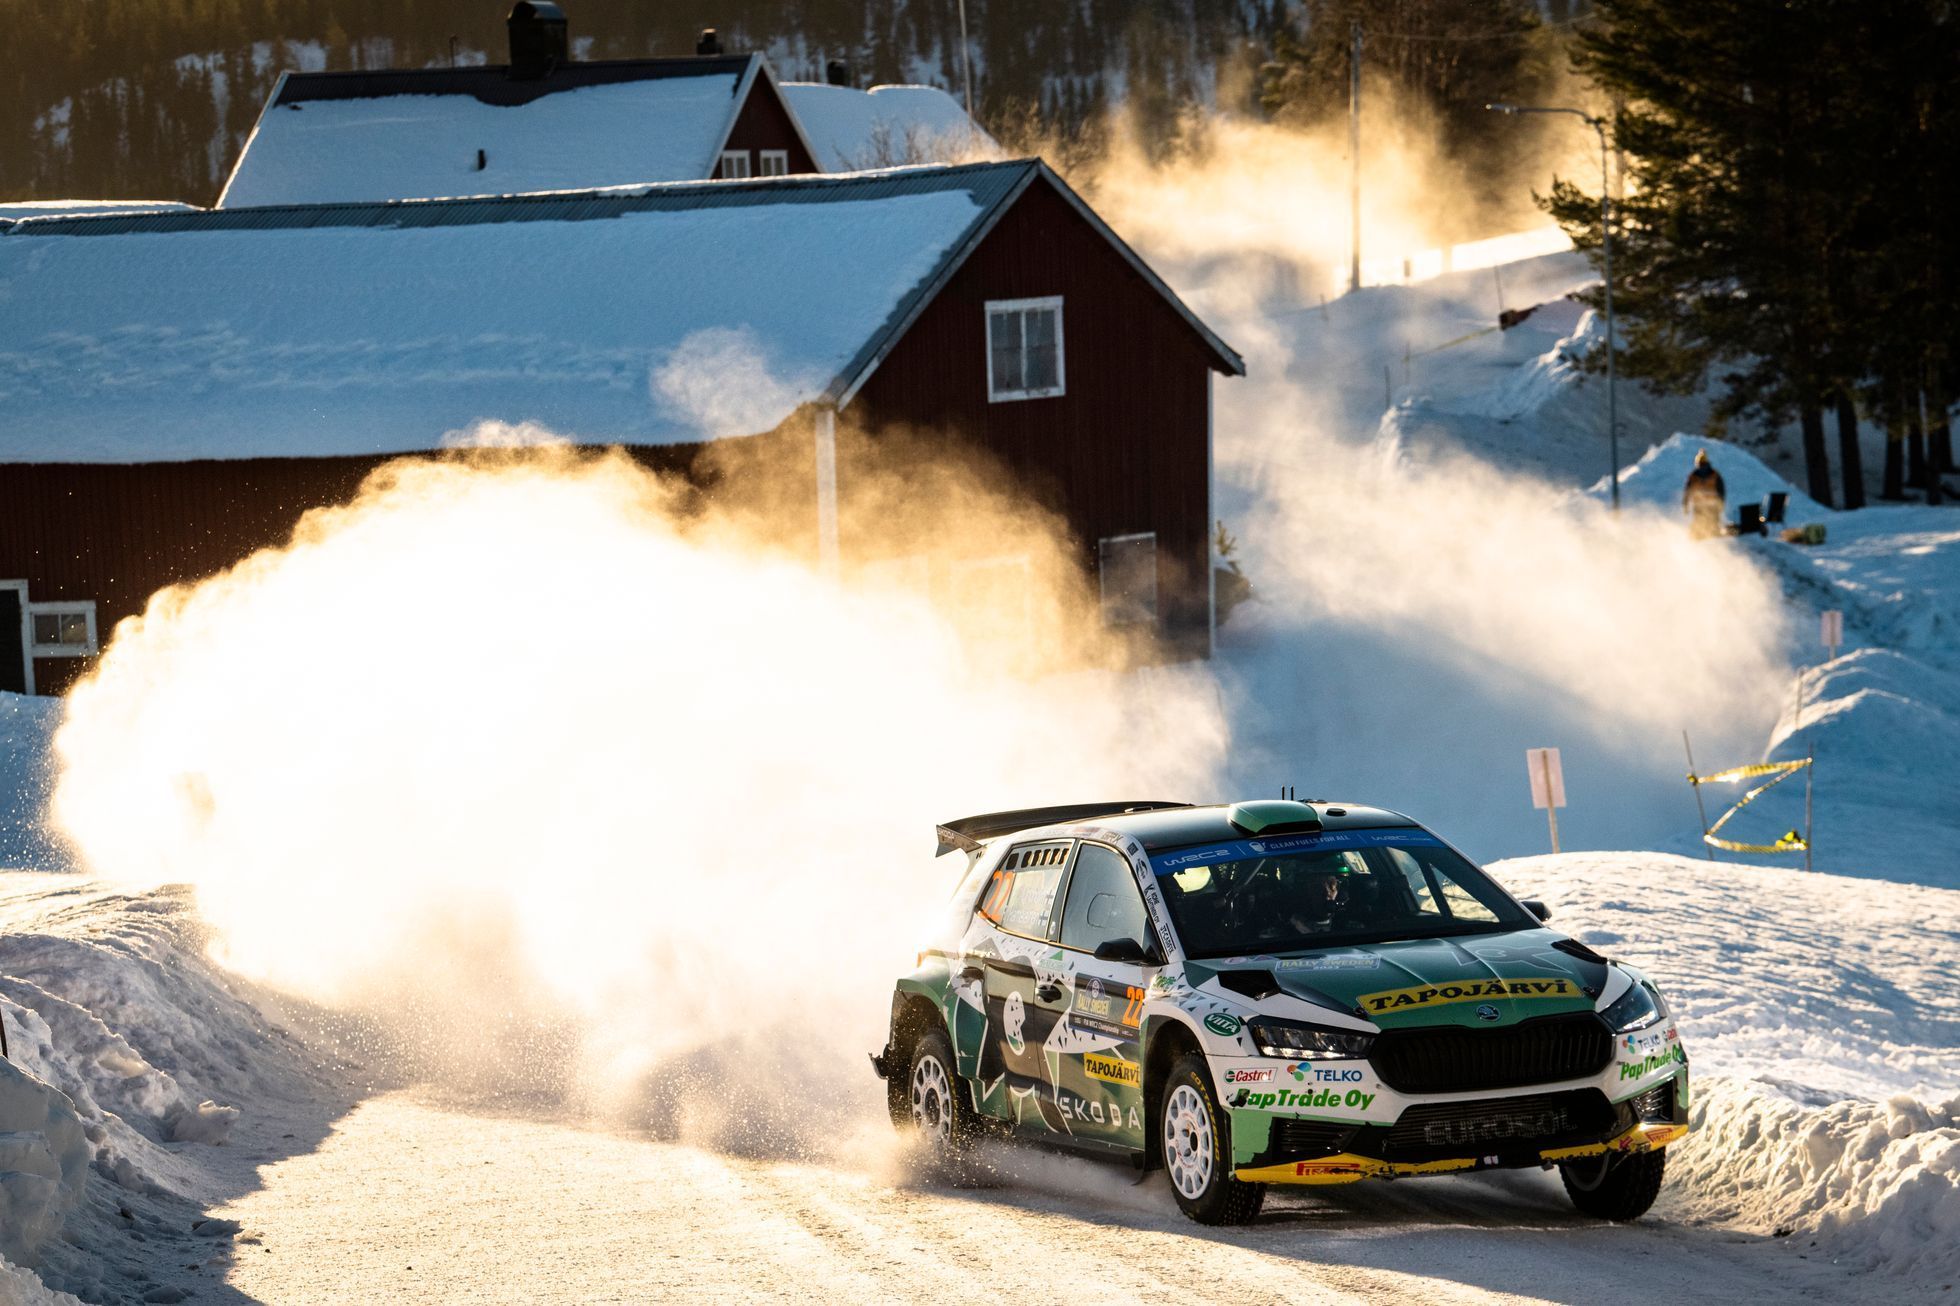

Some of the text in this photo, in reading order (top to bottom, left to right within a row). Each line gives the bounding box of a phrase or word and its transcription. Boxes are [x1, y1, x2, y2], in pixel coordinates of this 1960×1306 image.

[1270, 841, 1295, 849] CLEAN
[1296, 838, 1319, 846] FUELS
[1163, 849, 1231, 866] WRC2
[1281, 960, 1319, 968] RALLY
[1122, 985, 1145, 1028] 22
[1208, 1015, 1238, 1033] VIITA
[1235, 1070, 1272, 1082] Castrol
[1314, 1070, 1362, 1081] TELKO
[1345, 1089, 1376, 1110] Oy
